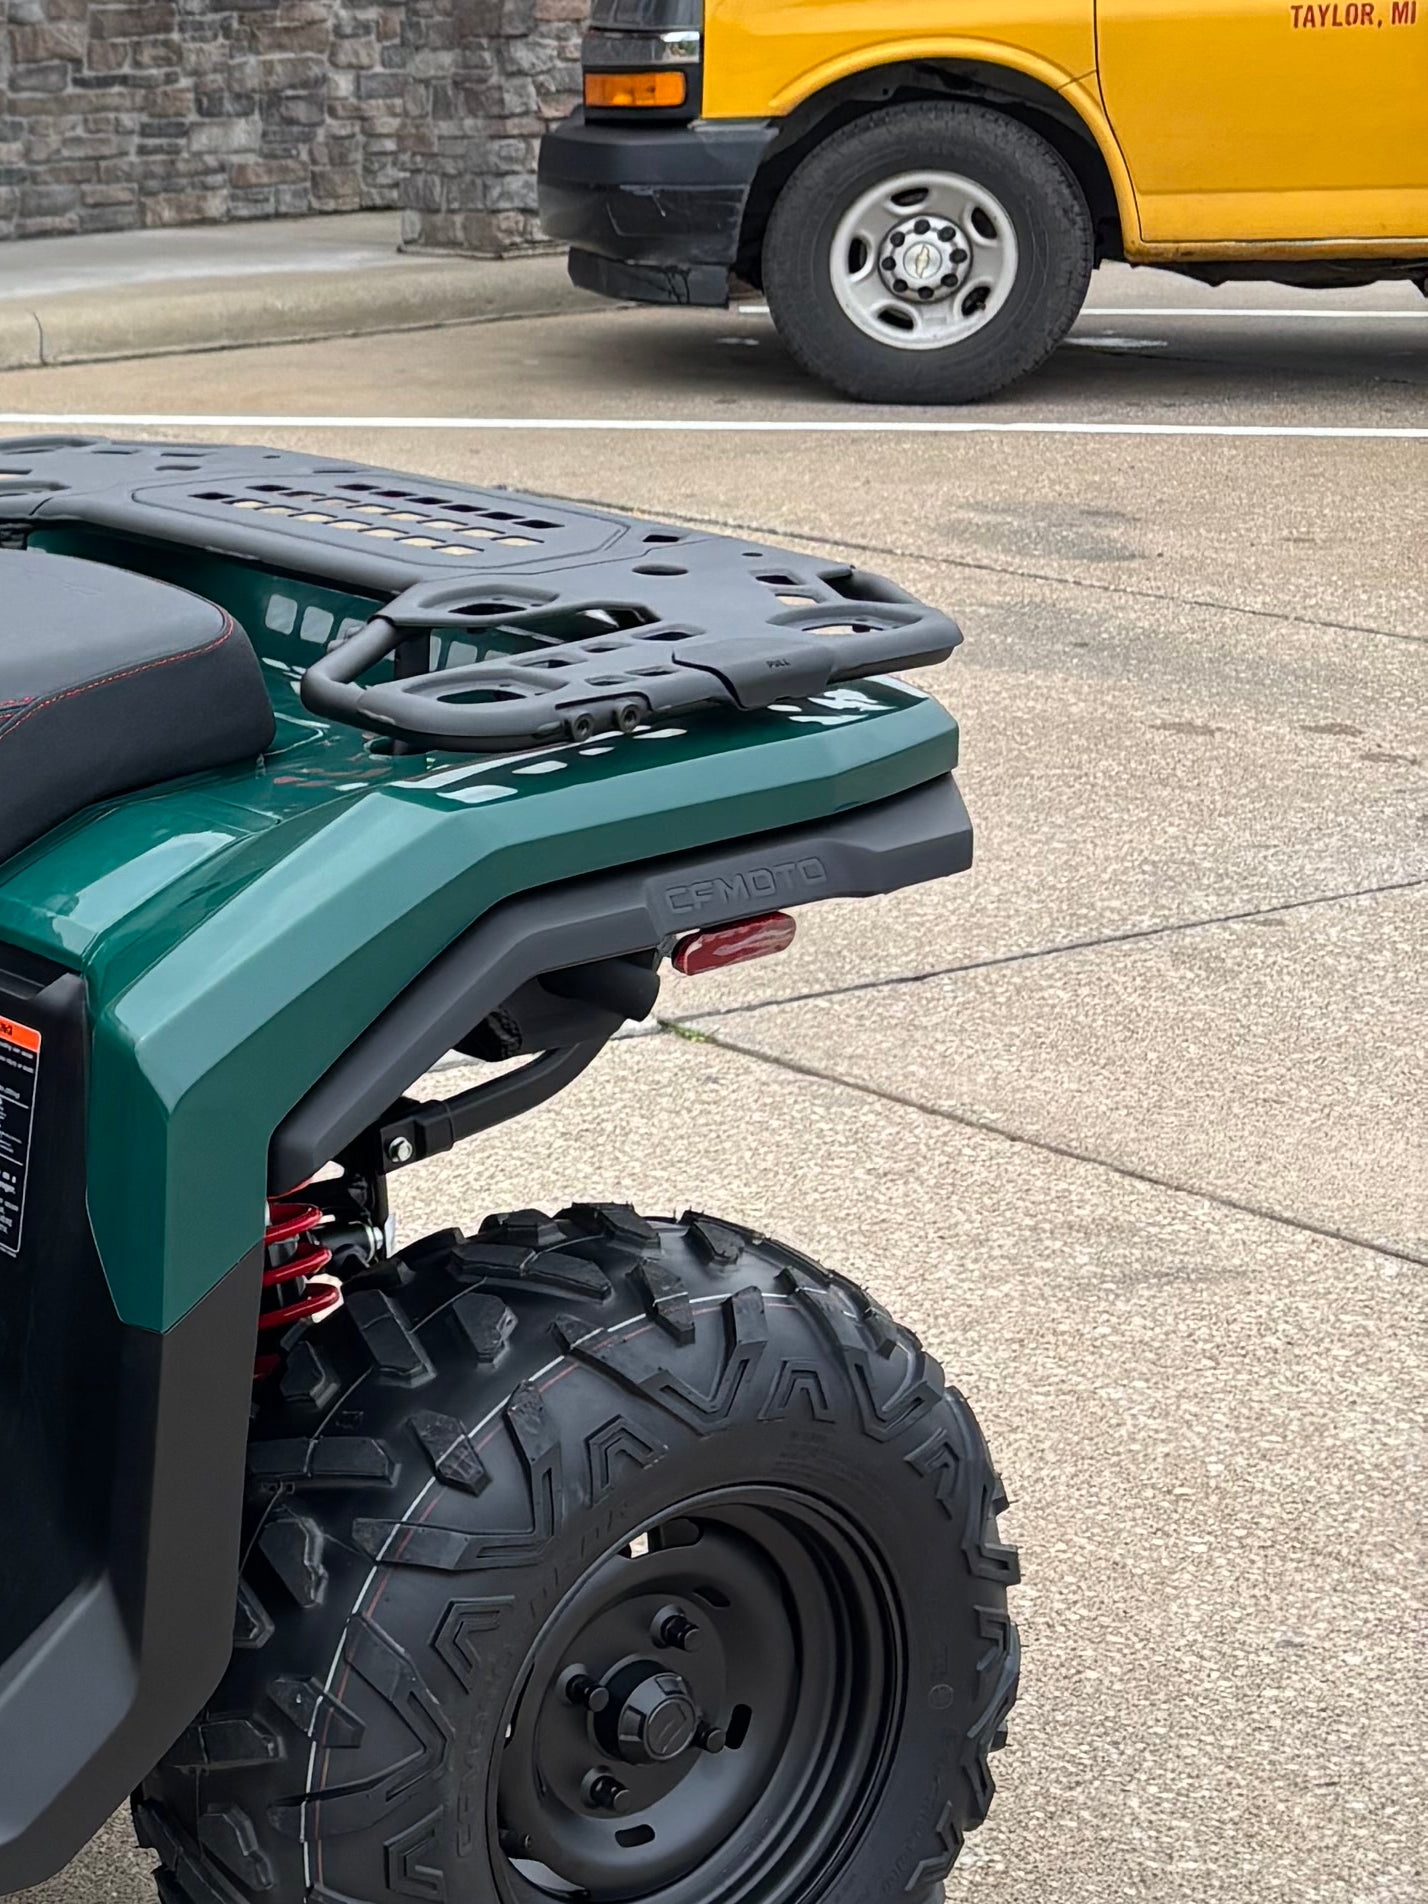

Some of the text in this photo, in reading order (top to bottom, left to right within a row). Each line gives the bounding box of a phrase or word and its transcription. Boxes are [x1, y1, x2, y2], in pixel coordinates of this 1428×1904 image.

[1291, 0, 1418, 29] TAYLOR, MI
[664, 856, 829, 915] CFMOTO
